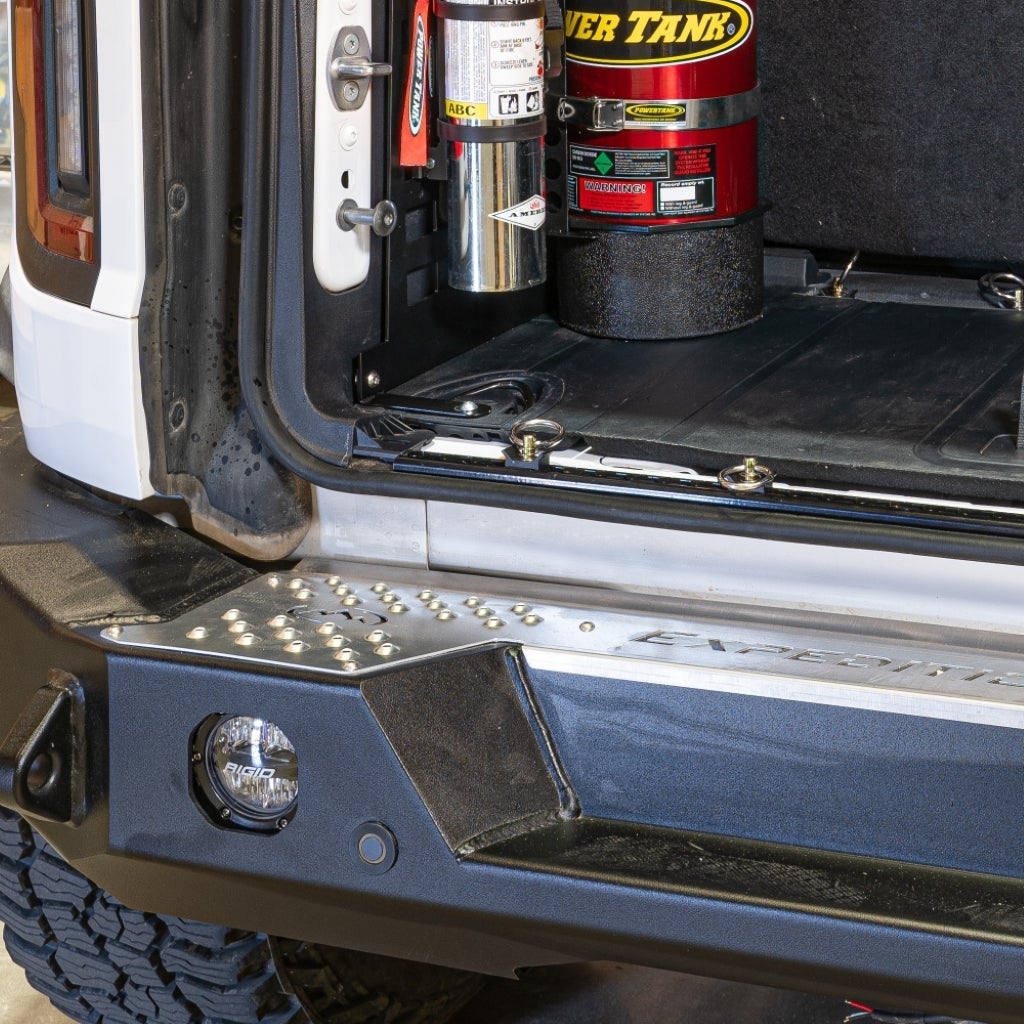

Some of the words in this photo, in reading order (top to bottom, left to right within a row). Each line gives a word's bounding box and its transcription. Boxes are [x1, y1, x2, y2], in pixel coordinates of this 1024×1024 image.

[624, 10, 732, 43] TANK
[416, 30, 425, 77] POWER
[411, 82, 423, 122] TANK
[448, 103, 476, 116] ABC
[584, 181, 646, 194] WARNING!
[223, 761, 276, 779] RIGID
